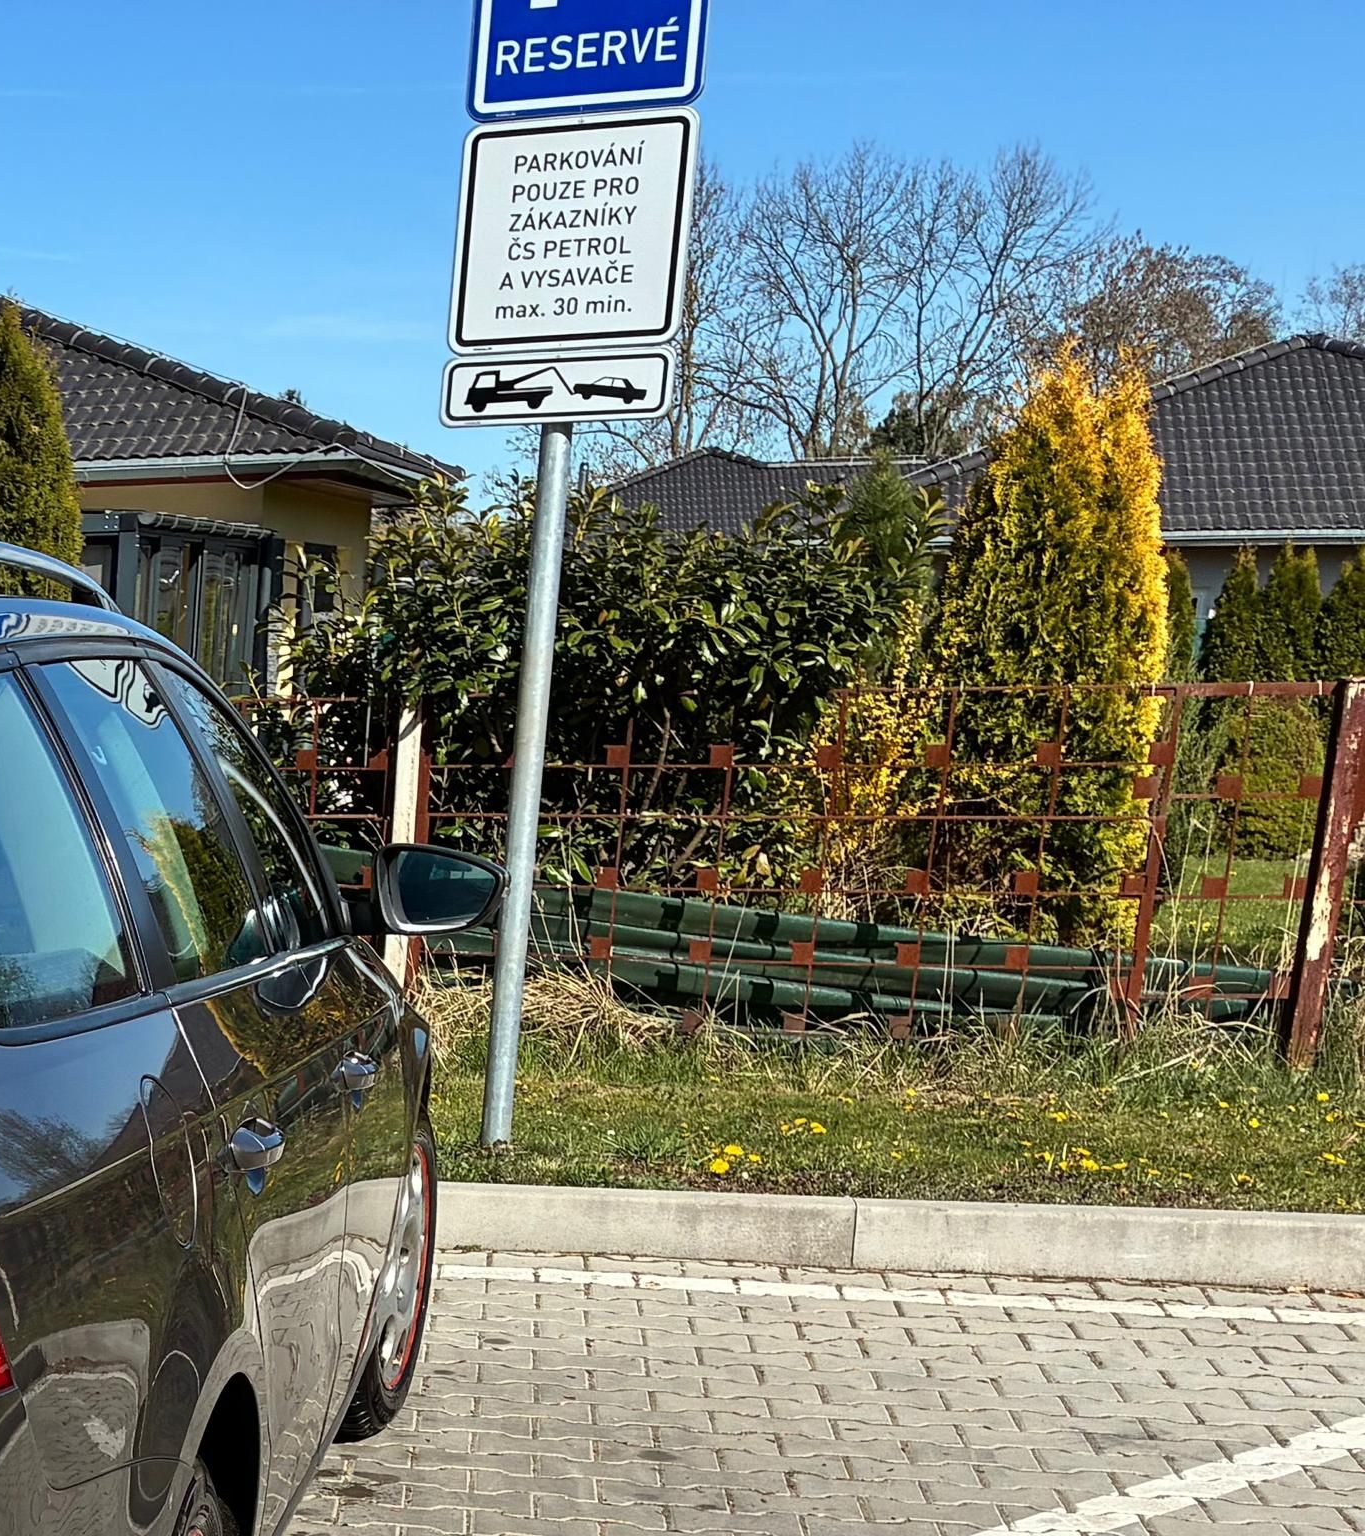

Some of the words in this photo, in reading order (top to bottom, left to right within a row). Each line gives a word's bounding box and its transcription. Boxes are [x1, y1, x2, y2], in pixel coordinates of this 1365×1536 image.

[495, 17, 679, 76] RESERVÉ
[514, 140, 645, 174] PARKOVÁNÍ
[512, 180, 586, 203] POUZE
[593, 176, 639, 197] PRO
[508, 202, 637, 232] ZÁKAZNÍKY
[507, 237, 535, 261] ČS
[543, 235, 632, 259] PETROL
[498, 272, 514, 290] A
[521, 259, 634, 289] VYSAVAČE
[495, 303, 545, 319] max.
[553, 297, 578, 316] 30
[585, 295, 632, 314] min.
